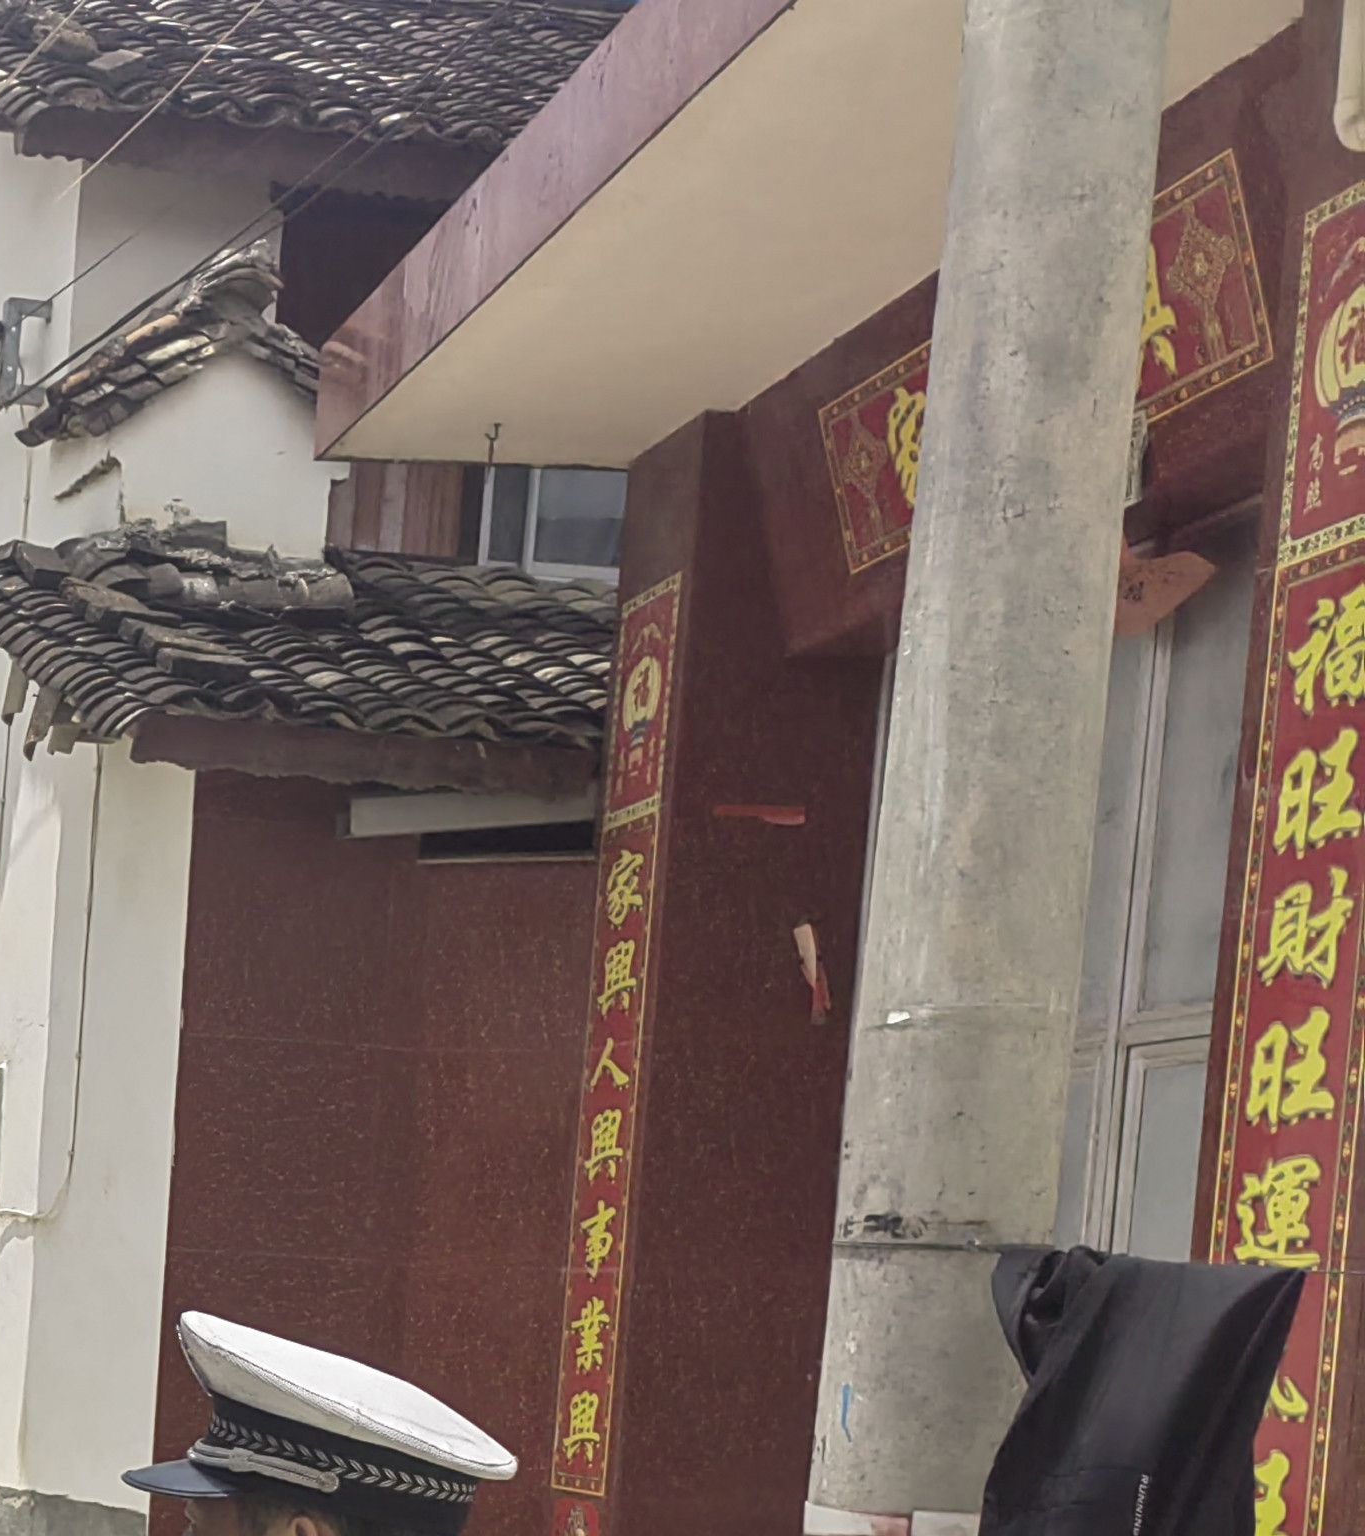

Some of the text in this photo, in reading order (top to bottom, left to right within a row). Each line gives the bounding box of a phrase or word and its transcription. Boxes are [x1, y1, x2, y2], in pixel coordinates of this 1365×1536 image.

[562, 849, 645, 1462] 家興人興事業興
